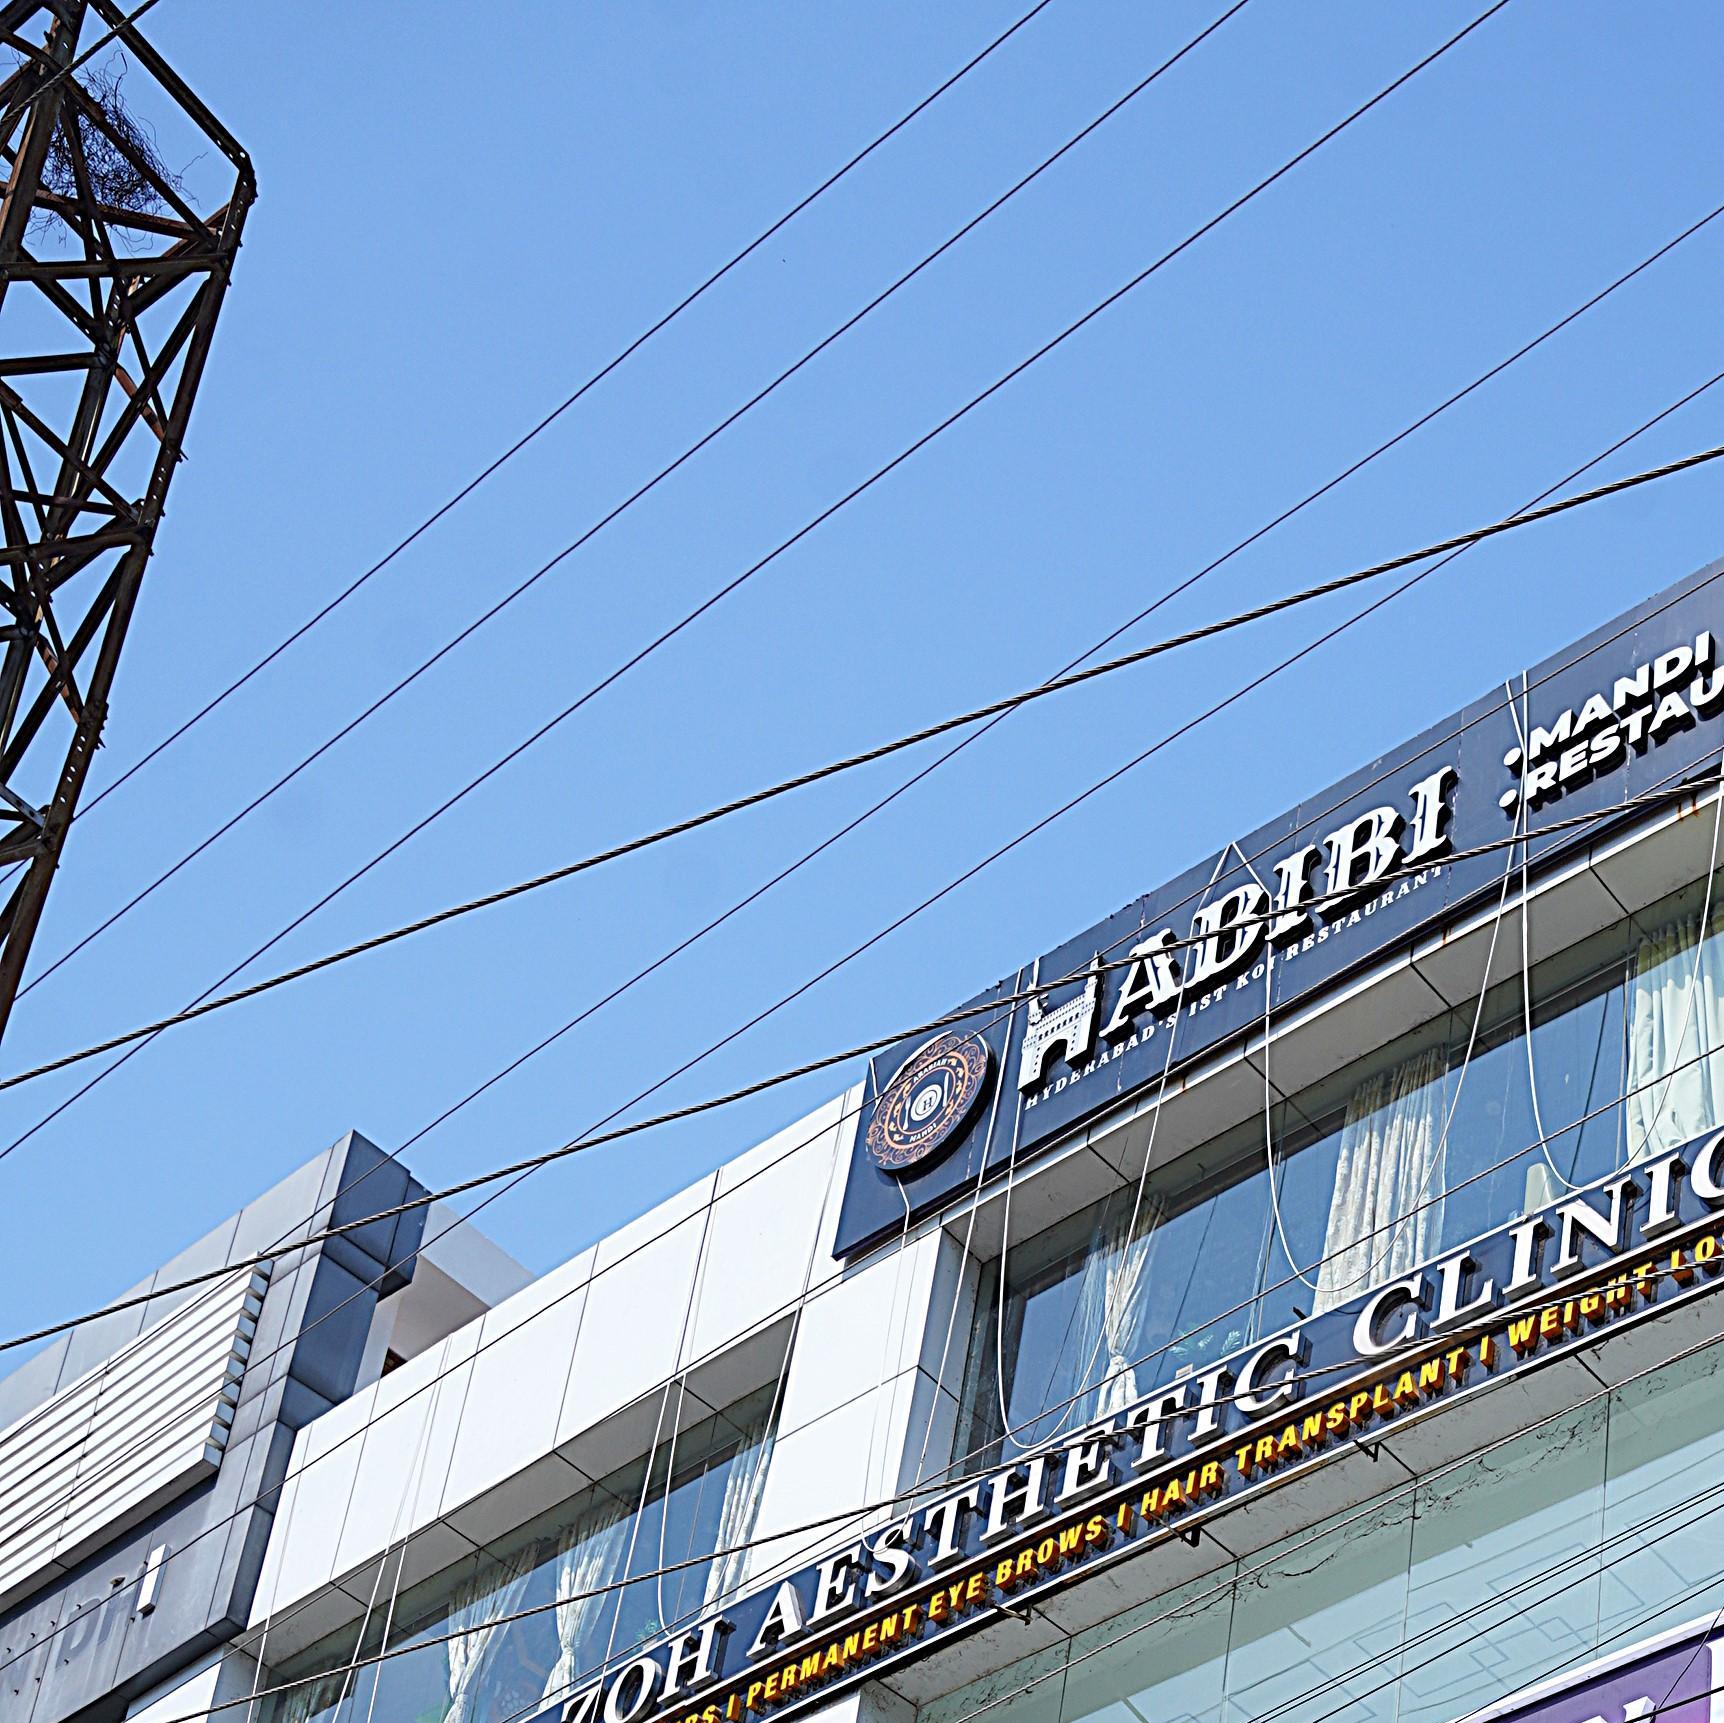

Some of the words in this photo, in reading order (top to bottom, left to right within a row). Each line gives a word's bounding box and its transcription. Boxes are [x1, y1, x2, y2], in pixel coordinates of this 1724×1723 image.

[1528, 630, 1711, 761] MANDI
[1285, 866, 1452, 961] RESTAURANT
[909, 1122, 938, 1143] MANDI
[746, 1603, 918, 1705] PERMANENT
[928, 1573, 984, 1619] EYE
[996, 1517, 1104, 1587] BROWS
[1140, 1459, 1219, 1515] HAIR
[1235, 1346, 1471, 1471] TRANSPLANT
[1507, 1261, 1655, 1349] WEIGHT
[747, 1333, 1301, 1658] AESTHETIC
